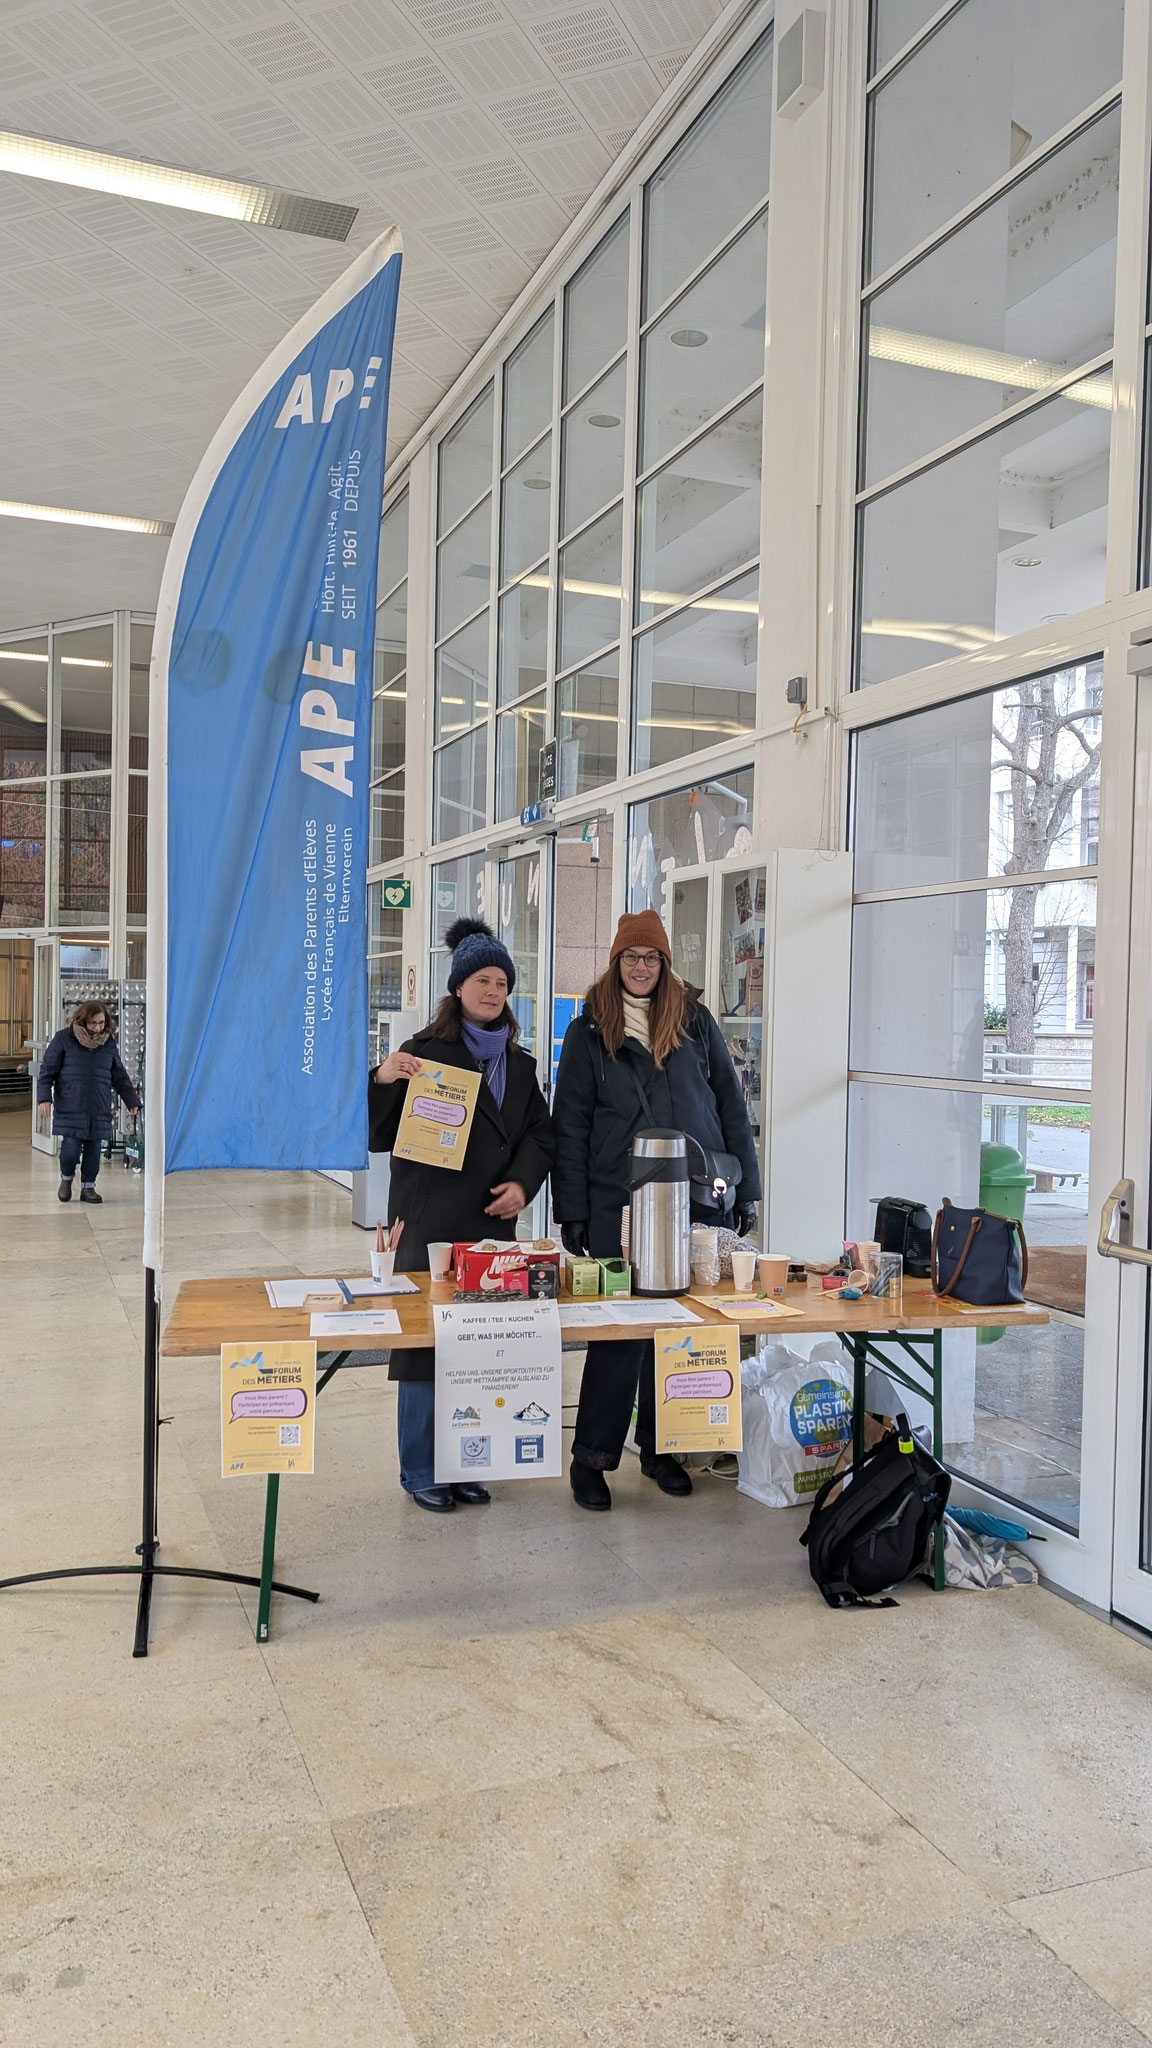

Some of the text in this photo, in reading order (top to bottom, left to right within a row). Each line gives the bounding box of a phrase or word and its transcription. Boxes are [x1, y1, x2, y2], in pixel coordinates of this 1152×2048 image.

[274, 356, 382, 428] APE
[328, 461, 344, 499] Agit.
[342, 450, 361, 619] SEIT 1961 DEPUIS
[321, 571, 335, 612] Hört.
[300, 641, 355, 798] APE
[338, 827, 352, 923] Elternverein
[304, 887, 317, 948] Parents
[321, 823, 336, 1021] Lycée Français de Vienne
[304, 952, 317, 981] des
[301, 985, 316, 1075] Association
[446, 1085, 467, 1095] FORUM
[457, 1333, 477, 1341] GEBT,
[701, 1349, 727, 1357] FORUM
[242, 1378, 256, 1386] DES
[274, 1367, 302, 1375] FORUM
[473, 1375, 509, 1383] WETTKÄMPFE
[503, 1367, 543, 1375] SPORTOUTFITS
[796, 1389, 846, 1403] Gemeinsam
[793, 1397, 854, 1420] PLASTIK
[797, 1415, 853, 1436] SPAREN
[811, 1442, 840, 1455] SPAR
[230, 1462, 244, 1470] APE
